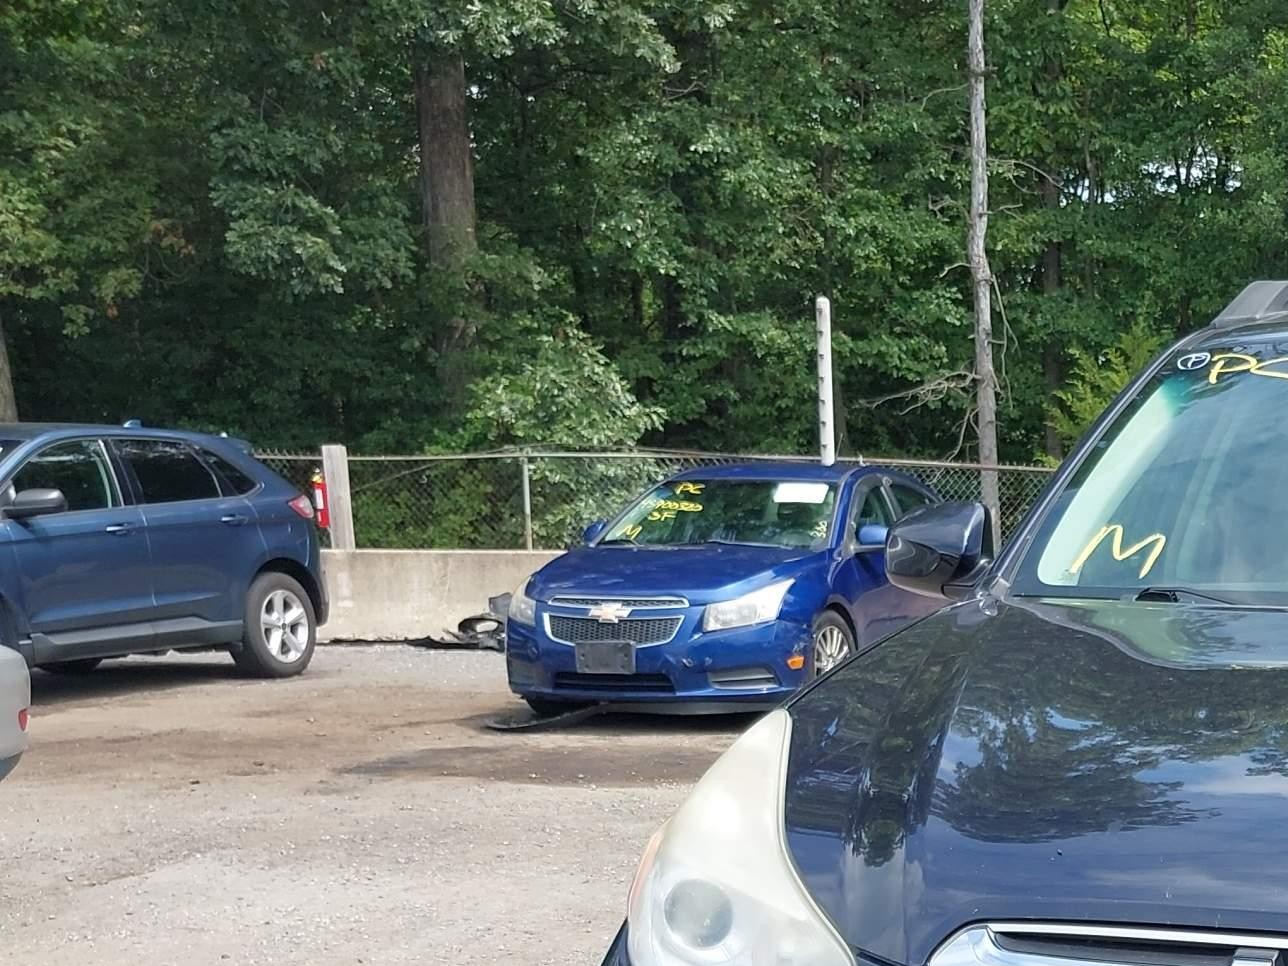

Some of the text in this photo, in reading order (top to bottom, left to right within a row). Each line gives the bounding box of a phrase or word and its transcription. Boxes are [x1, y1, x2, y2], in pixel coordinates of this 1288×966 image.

[674, 482, 707, 496] PC
[615, 523, 643, 541] M
[1069, 524, 1168, 580] M
